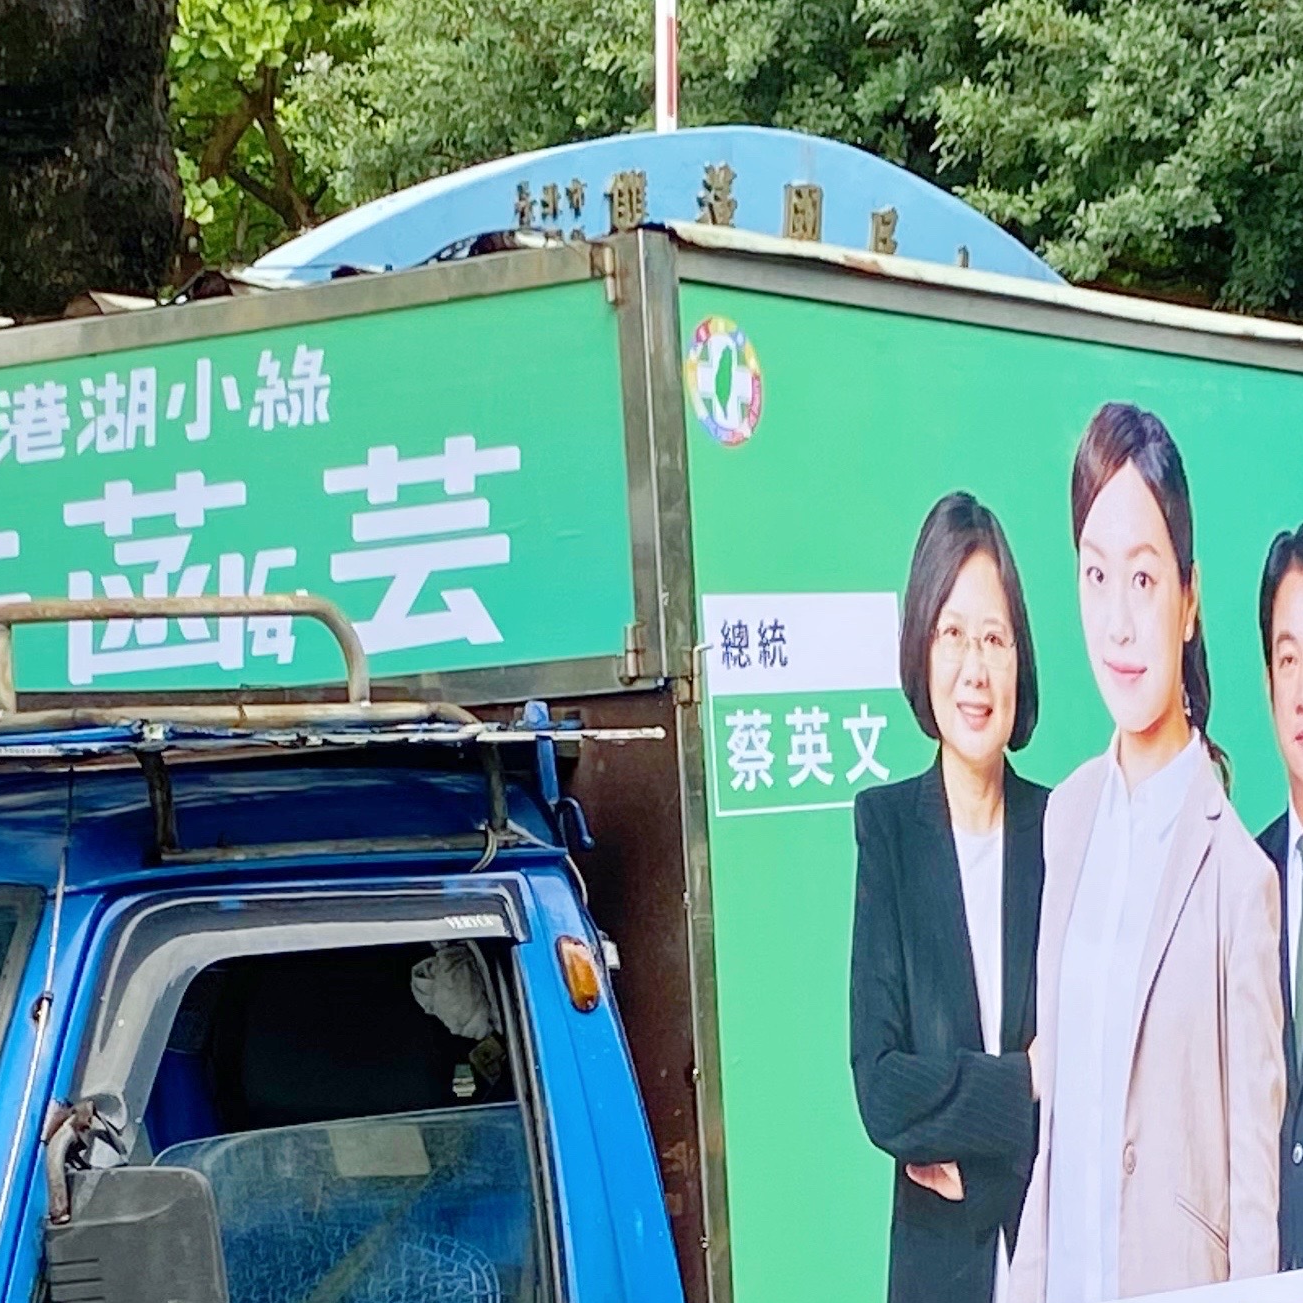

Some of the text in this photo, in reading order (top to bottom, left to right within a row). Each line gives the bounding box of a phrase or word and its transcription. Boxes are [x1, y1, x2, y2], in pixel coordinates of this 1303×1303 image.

[720, 618, 788, 669] 總統
[725, 703, 890, 791] 蔡英文
